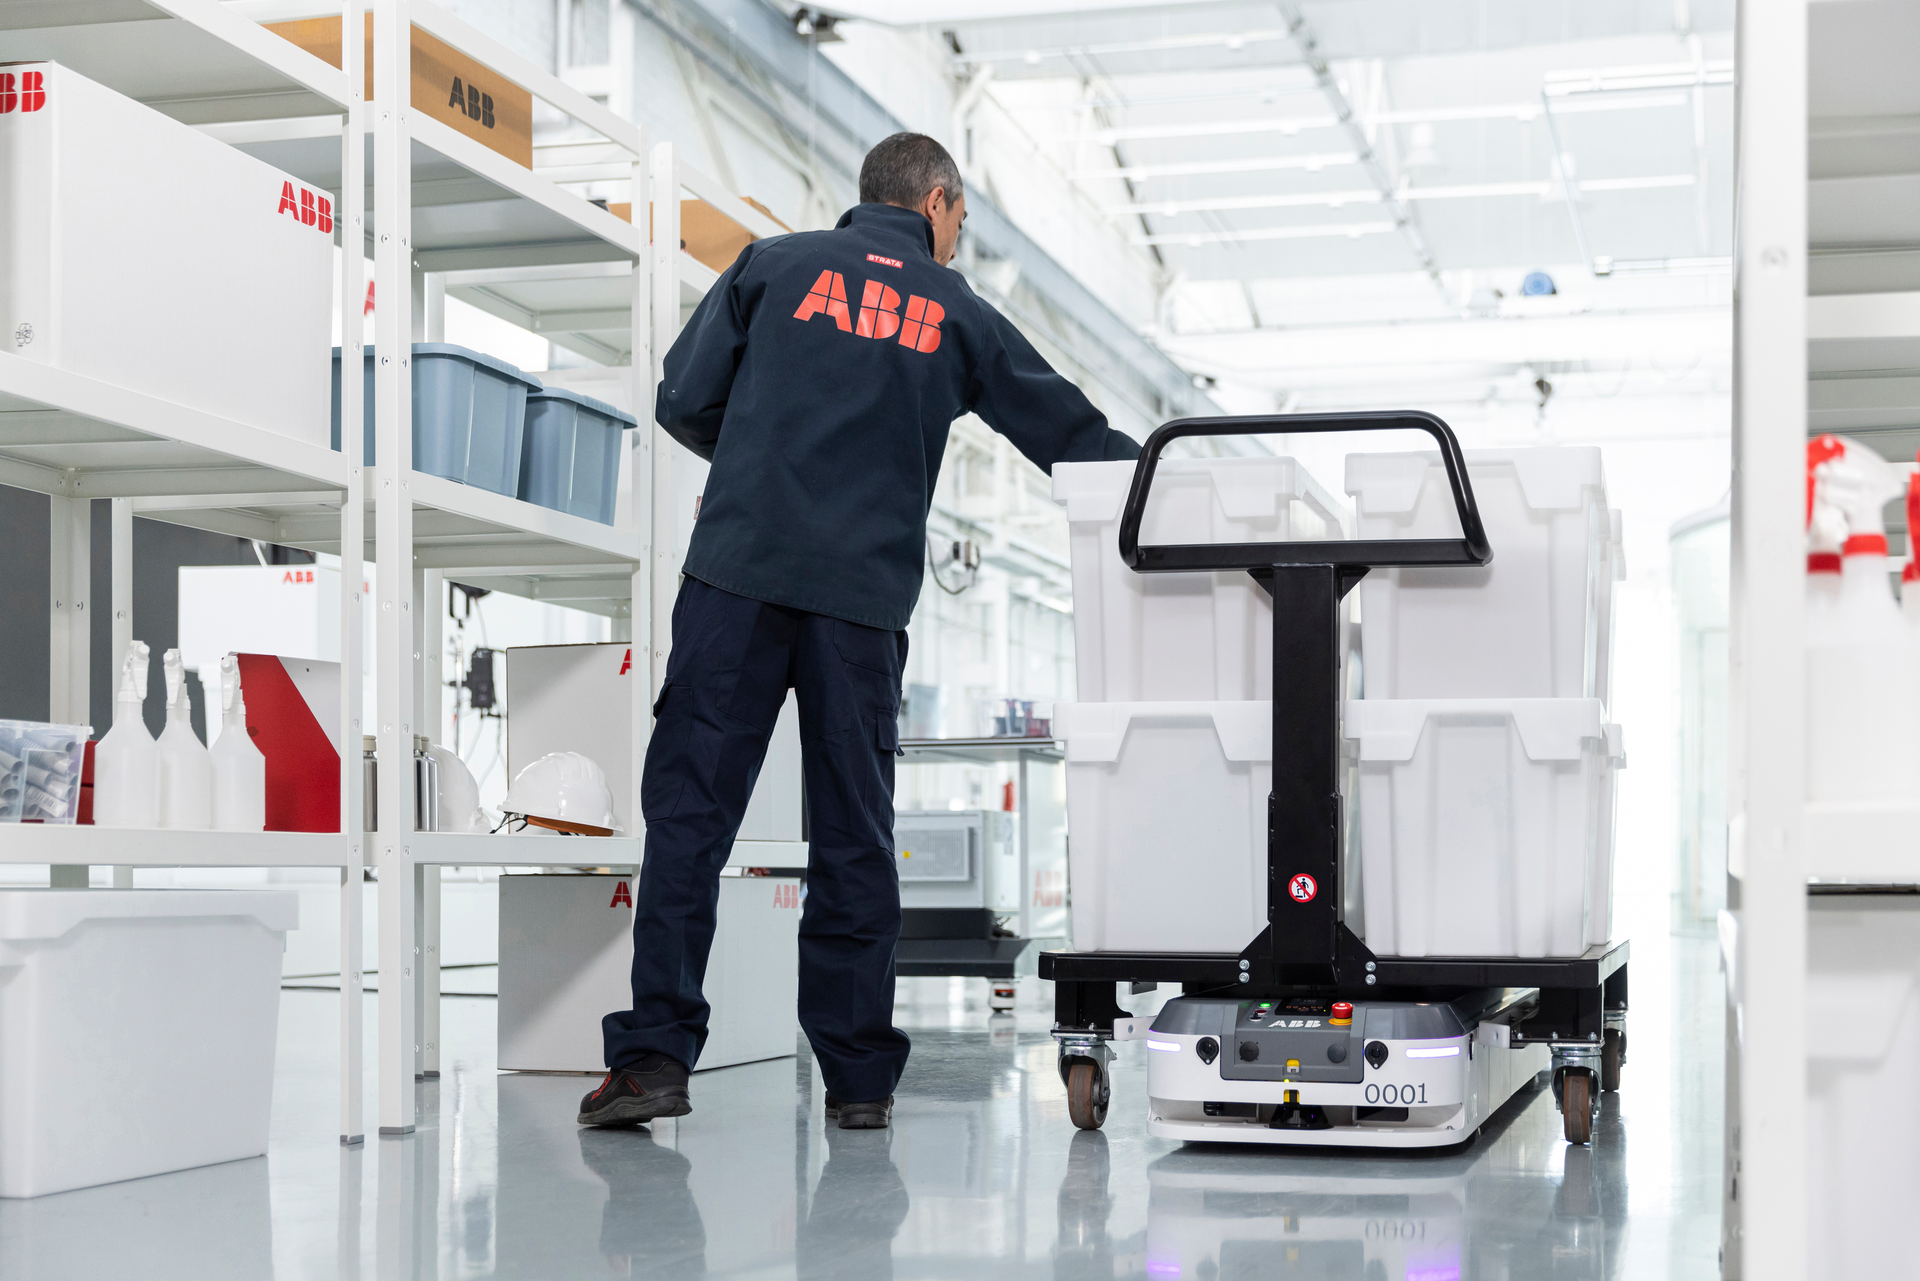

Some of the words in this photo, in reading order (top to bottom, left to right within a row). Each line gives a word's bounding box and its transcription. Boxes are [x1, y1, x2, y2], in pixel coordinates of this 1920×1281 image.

[448, 76, 496, 130] ABB
[277, 180, 333, 234] ABB
[868, 254, 902, 267] STRATA
[792, 269, 946, 354] ABB
[283, 571, 314, 584] ABB
[773, 884, 799, 909] ABB
[1268, 1019, 1321, 1028] ABB
[1364, 1083, 1428, 1105] 0001
